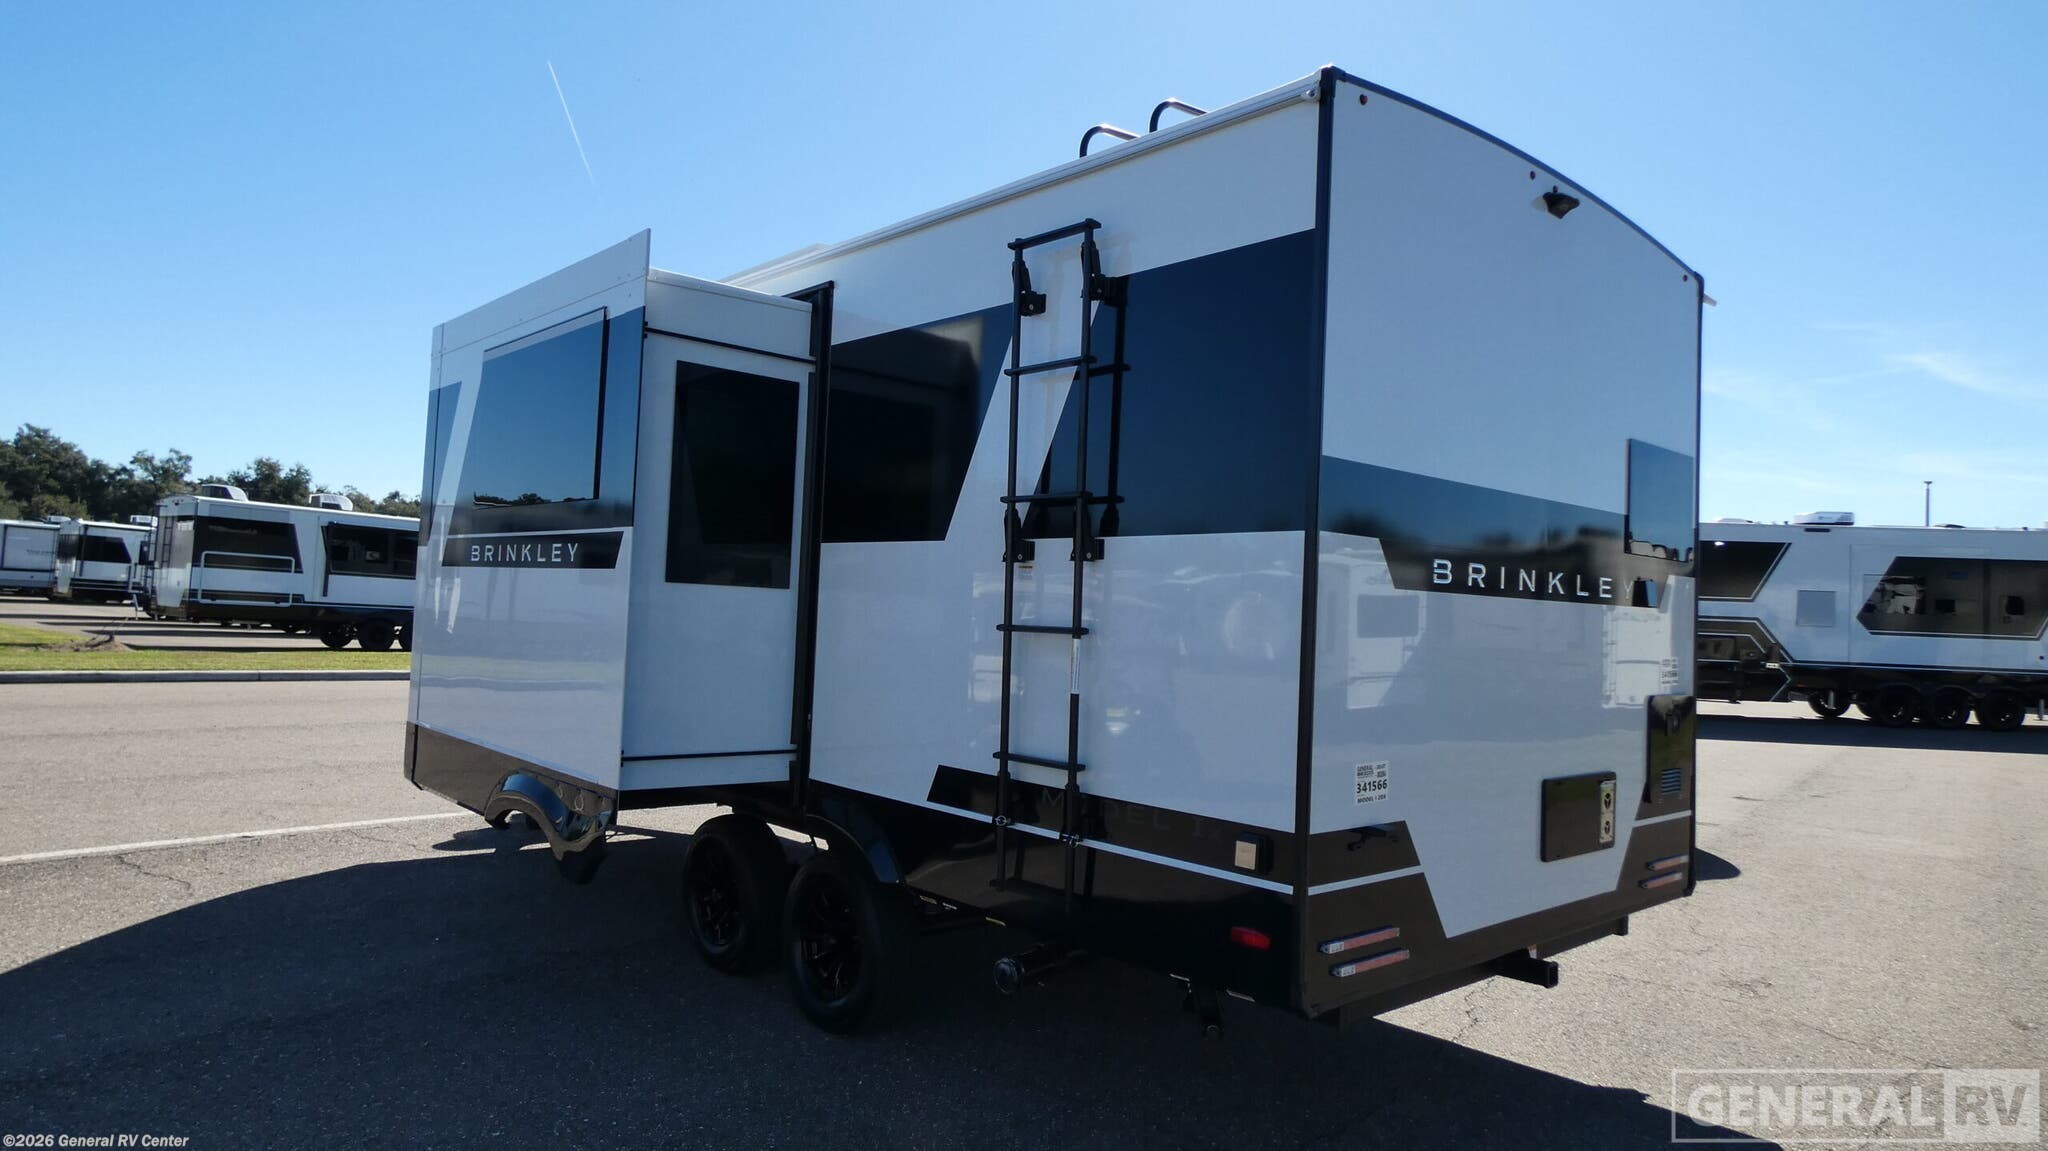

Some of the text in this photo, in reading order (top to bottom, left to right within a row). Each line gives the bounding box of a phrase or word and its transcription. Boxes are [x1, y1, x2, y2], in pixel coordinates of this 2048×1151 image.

[470, 542, 580, 562] BRINKLEY
[1432, 558, 1634, 600] BRINKLEY
[1356, 779, 1388, 794] 341566
